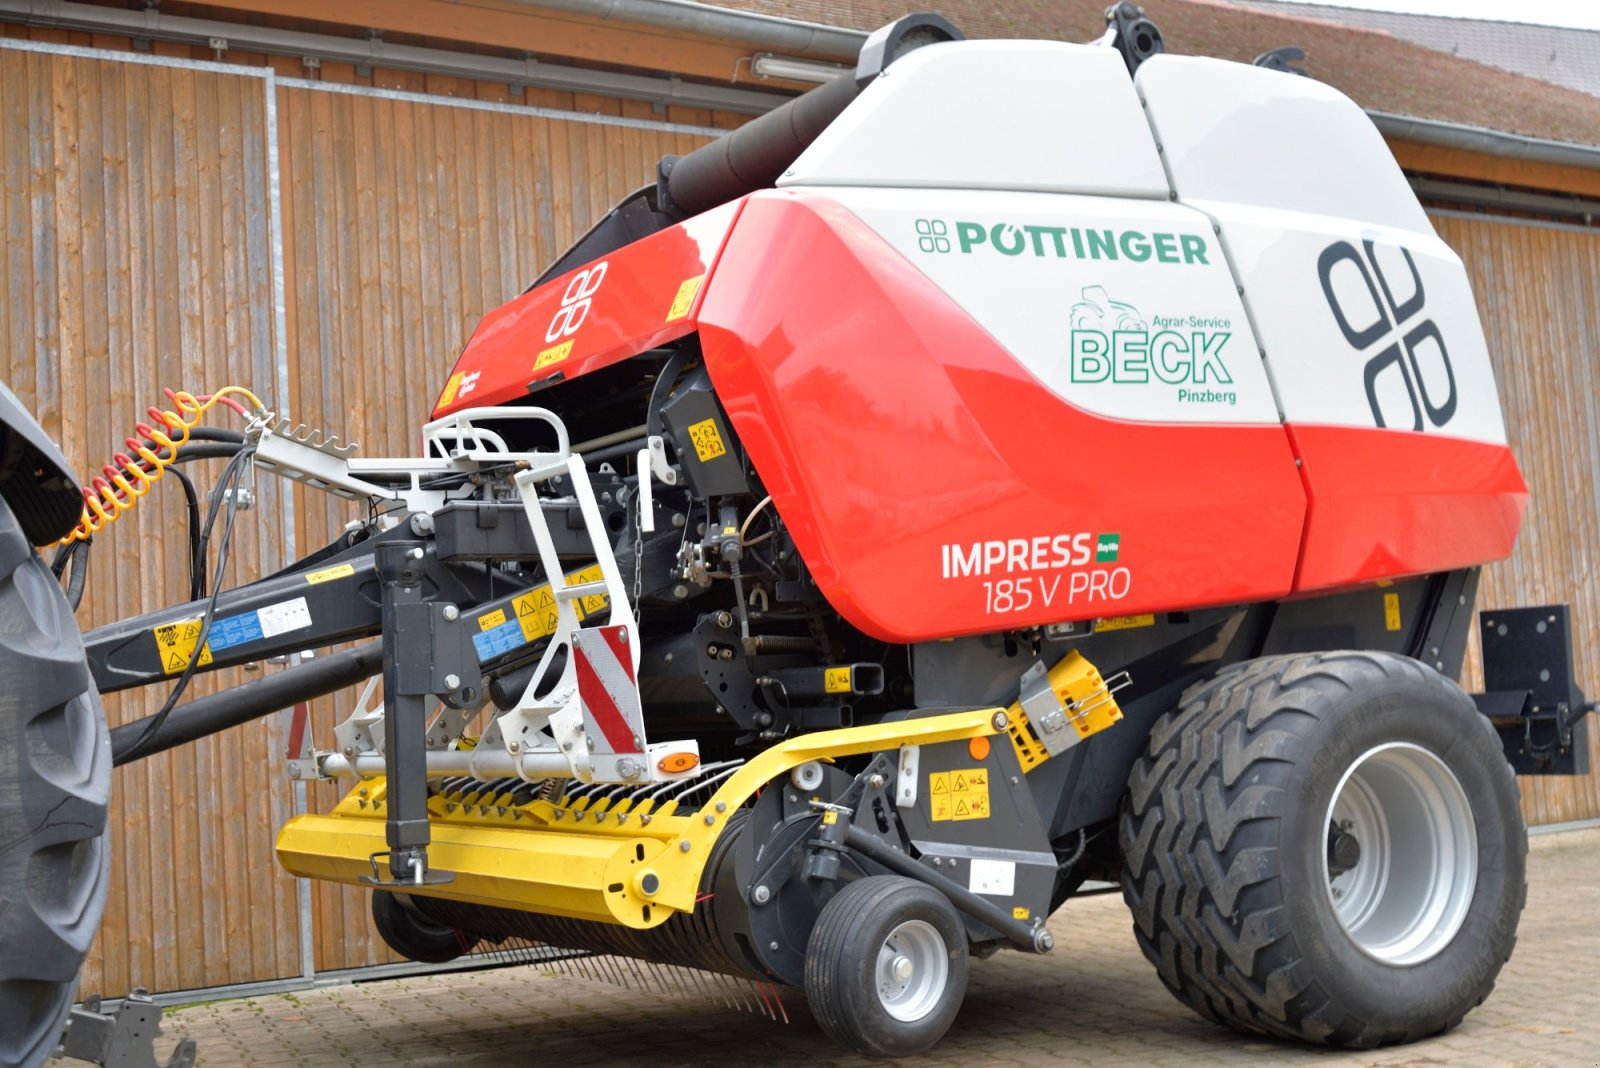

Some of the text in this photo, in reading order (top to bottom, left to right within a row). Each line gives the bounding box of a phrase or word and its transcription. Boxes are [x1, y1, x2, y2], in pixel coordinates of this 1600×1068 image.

[956, 222, 1210, 264] PÖTTINGER
[1152, 315, 1231, 329] Agrar-Service
[1071, 329, 1233, 384] BECK
[1178, 389, 1237, 404] Pinzberg
[942, 532, 1091, 578] IMPRESS
[983, 567, 1131, 614] 185 V PRO
